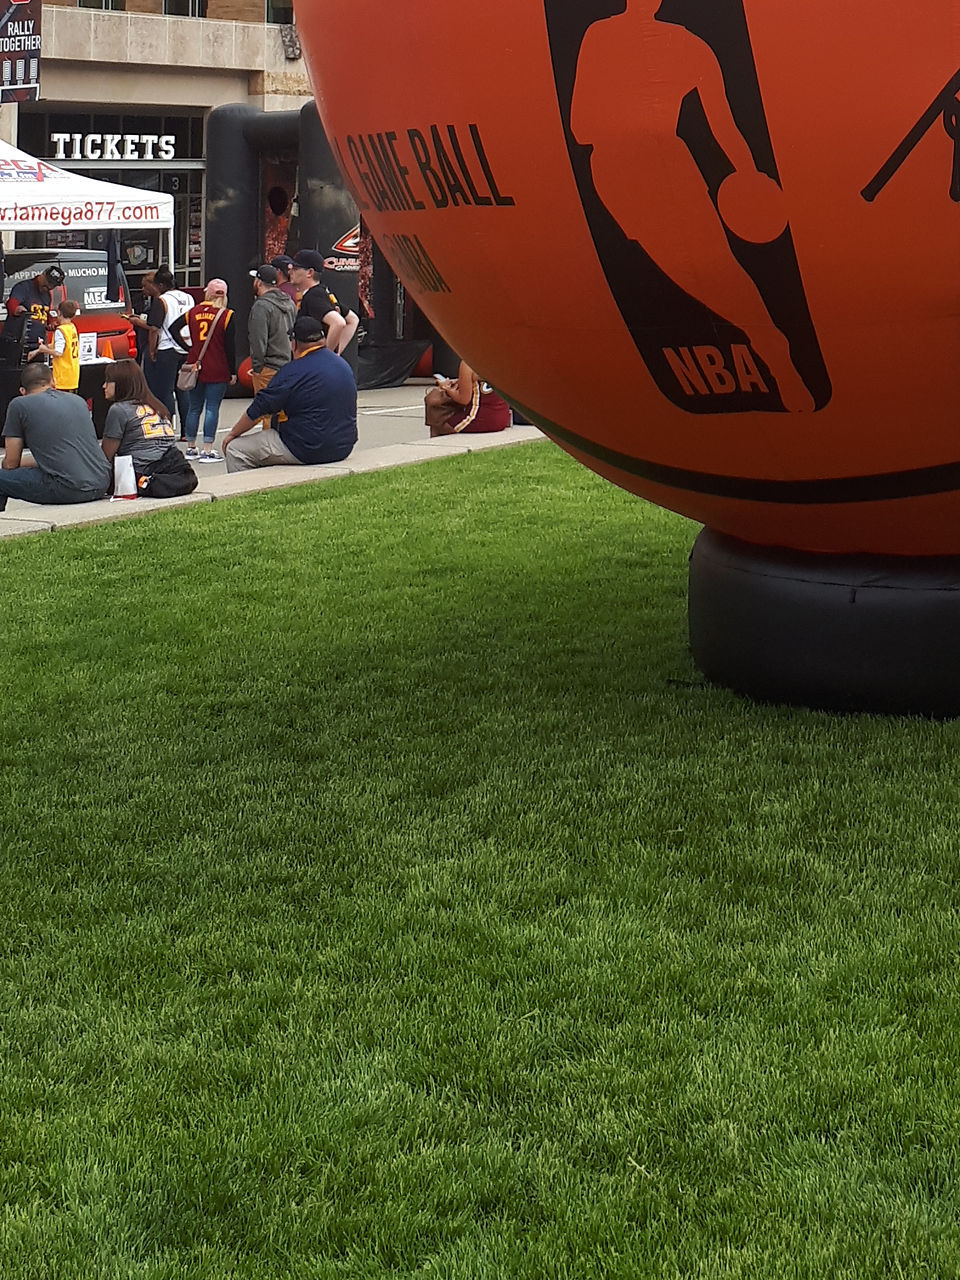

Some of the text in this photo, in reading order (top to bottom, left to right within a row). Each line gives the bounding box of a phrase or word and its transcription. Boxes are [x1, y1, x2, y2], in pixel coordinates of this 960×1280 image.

[7, 20, 34, 36] RALLY
[0, 35, 41, 52] TOGETHER
[51, 133, 175, 159] TICKETS
[346, 131, 426, 212] GAME
[407, 124, 515, 208] BALL
[172, 177, 179, 190] 3
[68, 268, 98, 277] MUCHO
[200, 321, 208, 341] 2
[662, 344, 770, 395] NBA
